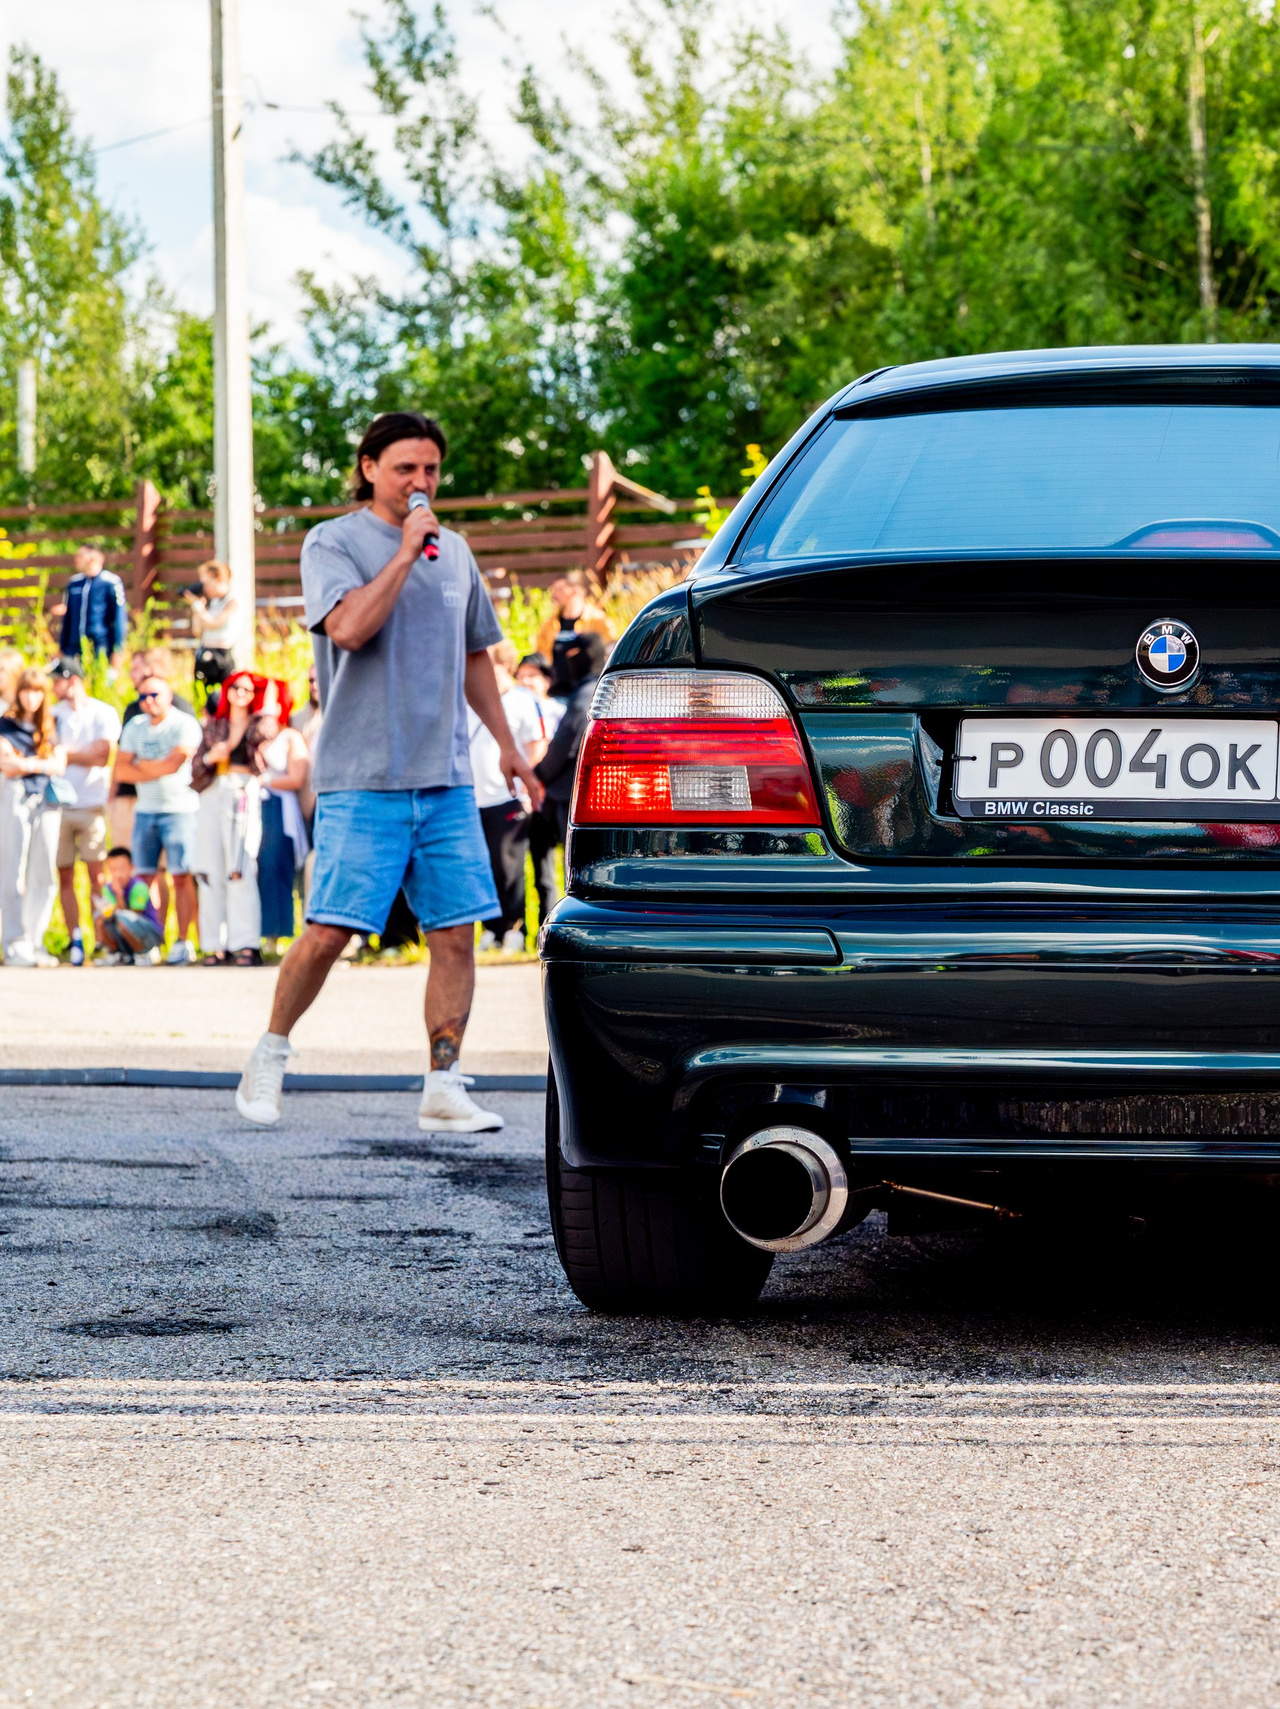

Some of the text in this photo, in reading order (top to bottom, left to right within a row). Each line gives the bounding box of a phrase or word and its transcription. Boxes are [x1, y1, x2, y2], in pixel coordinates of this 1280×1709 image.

[1143, 625, 1194, 645] BMW
[984, 801, 1094, 816] BMW Classic
